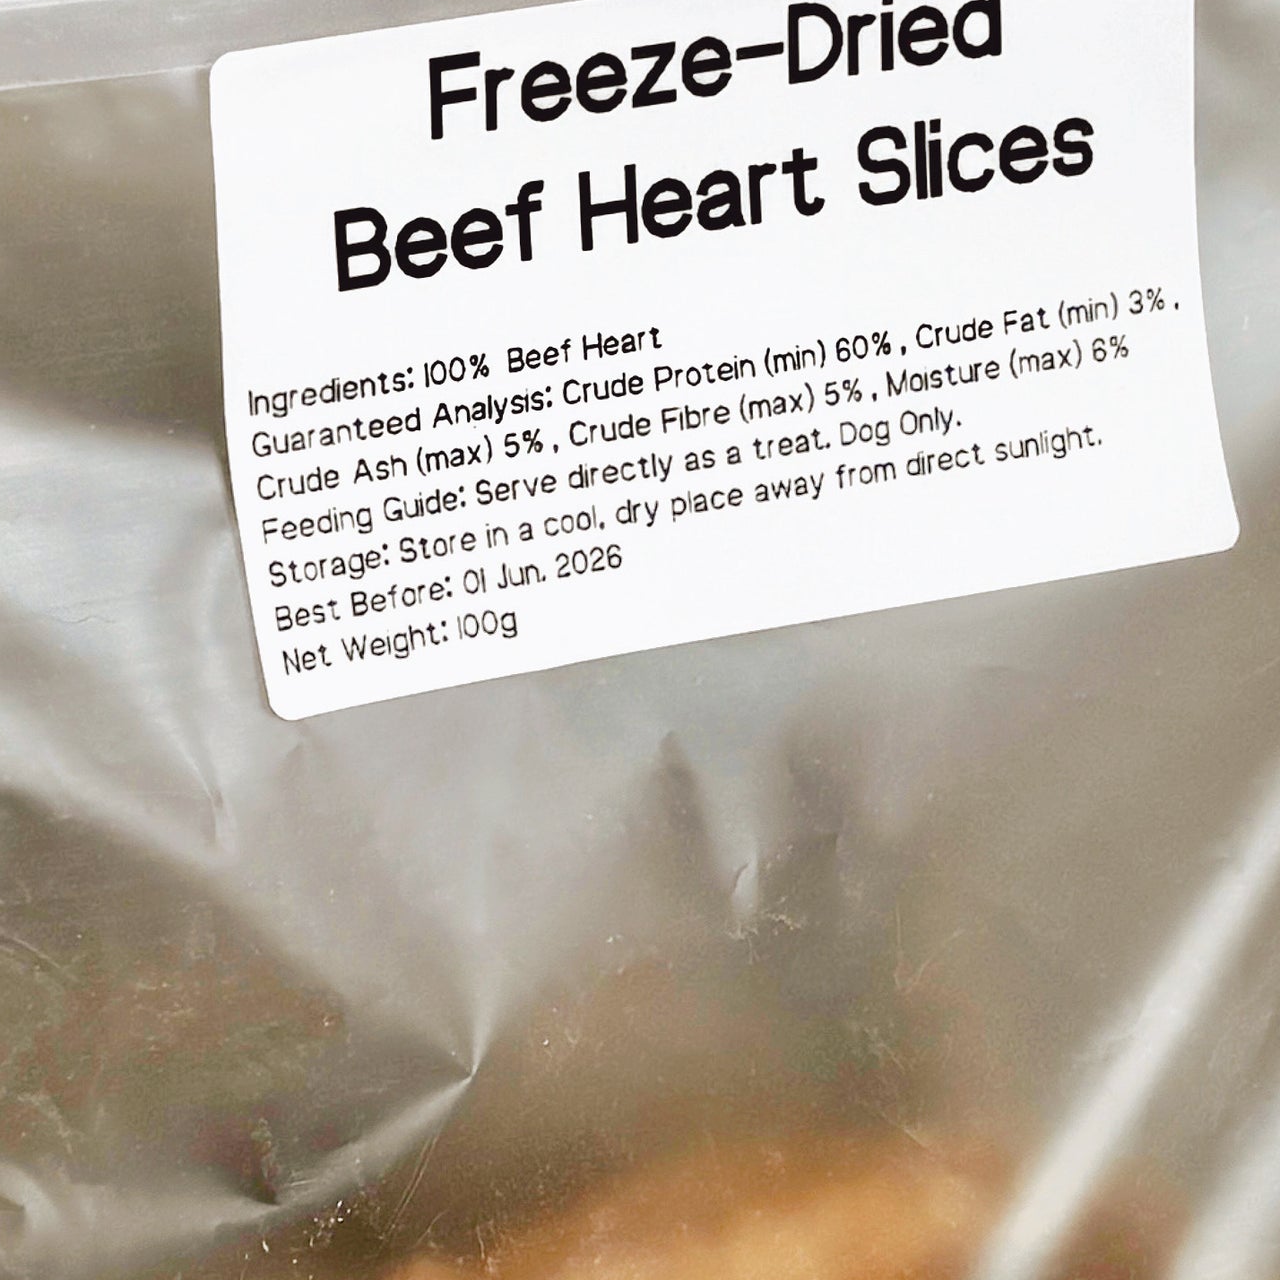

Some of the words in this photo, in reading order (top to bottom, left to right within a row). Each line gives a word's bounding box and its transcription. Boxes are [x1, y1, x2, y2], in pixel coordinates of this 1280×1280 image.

[333, 179, 545, 293] Beef
[577, 147, 826, 252] Heart
[856, 116, 1095, 207] Slices
[248, 366, 415, 419] Ingredients:
[423, 352, 490, 389] 100%
[506, 337, 572, 374] Beef
[581, 326, 663, 361] Heart
[251, 406, 422, 458] Guaranteed
[432, 385, 553, 425] Analysis:
[562, 371, 644, 405] Crude
[653, 354, 757, 392] Protein
[763, 338, 827, 378] (min)
[915, 317, 994, 349] Crude
[1003, 307, 1051, 336] Fat
[1058, 291, 1118, 330] (min)
[256, 466, 340, 501] Crude
[353, 454, 408, 485] Ash
[416, 434, 493, 477] (max)
[568, 413, 651, 447] Crude
[660, 404, 731, 434] Fibre
[739, 381, 815, 424] (max)
[885, 359, 1000, 398] Moisture
[1009, 338, 1083, 380] (max)
[1091, 334, 1130, 363] 6%
[261, 506, 374, 545] Feeding
[383, 485, 467, 522] Guide:
[475, 473, 558, 506] Serve
[568, 452, 673, 490] directly
[684, 449, 716, 472] as
[725, 445, 742, 466] a
[752, 428, 831, 461] treat.
[839, 420, 891, 447] Dog
[899, 406, 962, 436] Only.
[268, 542, 390, 588] Storage:
[399, 531, 477, 564] Store
[486, 526, 509, 549] in
[518, 521, 534, 542] a
[615, 498, 659, 528] dry
[670, 487, 744, 523] place
[754, 472, 825, 503] away
[835, 461, 897, 490] from
[906, 443, 986, 477] direct
[994, 426, 1102, 462] sunlight.
[274, 599, 341, 632] Best
[350, 575, 453, 617] Before:
[497, 562, 547, 590] Jun.
[555, 543, 623, 579] 2026
[282, 644, 333, 676] Net
[340, 620, 449, 662] Weight:
[456, 609, 518, 640] 100g
